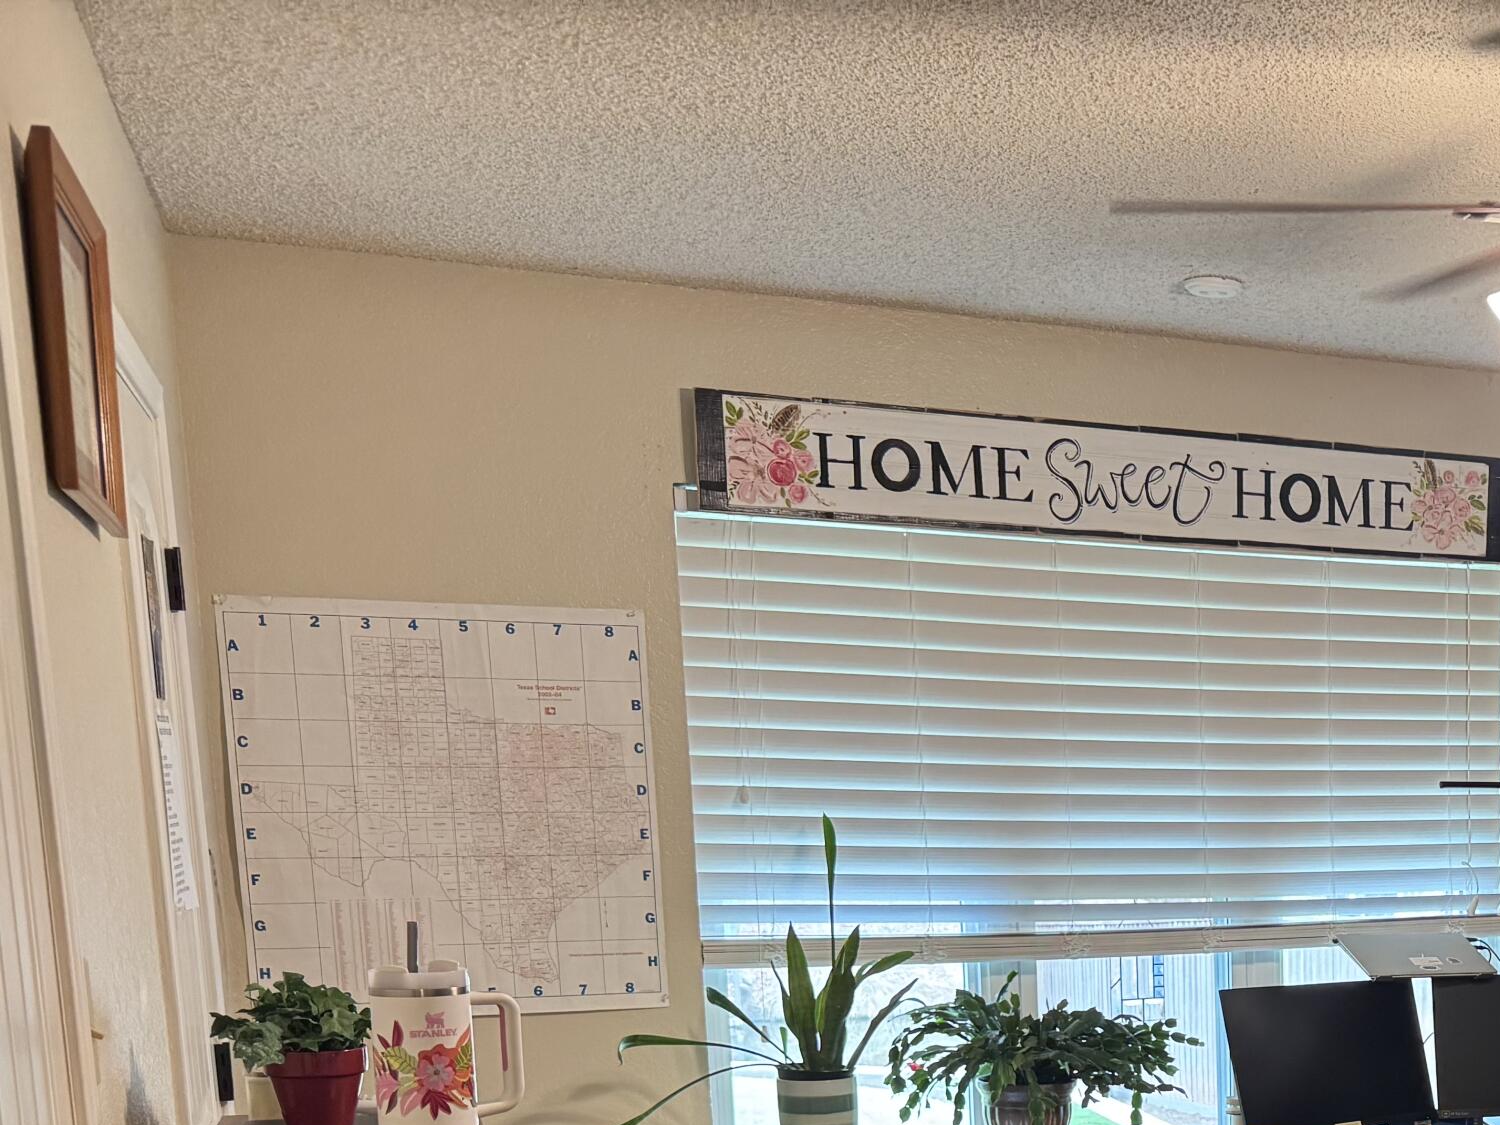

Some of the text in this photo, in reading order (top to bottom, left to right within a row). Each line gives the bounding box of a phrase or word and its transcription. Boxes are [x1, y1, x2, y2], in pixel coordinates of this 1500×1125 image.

[812, 432, 1415, 532] HOME Sweet HOME
[257, 614, 268, 627] 1
[309, 615, 321, 628] 2
[361, 615, 371, 630] 3
[407, 617, 419, 631] 4
[458, 619, 469, 633] 5
[505, 622, 516, 635] 6
[552, 622, 562, 636] 7
[604, 624, 615, 638] 8
[227, 639, 240, 652] A
[628, 649, 641, 662] A
[231, 688, 245, 701] B
[630, 699, 642, 711] B
[236, 735, 249, 748] C
[633, 742, 644, 754] C
[240, 782, 253, 796] D
[636, 784, 647, 796] D
[245, 827, 257, 840] E
[639, 828, 650, 840] E
[250, 873, 261, 886] F
[642, 869, 651, 882] F
[644, 912, 656, 924] G
[254, 919, 267, 932] G
[647, 955, 658, 967] H
[259, 967, 272, 980] H
[533, 985, 544, 998] 6
[578, 983, 588, 997] 7
[625, 982, 635, 995] 8
[409, 1028, 458, 1038] STANLEY
